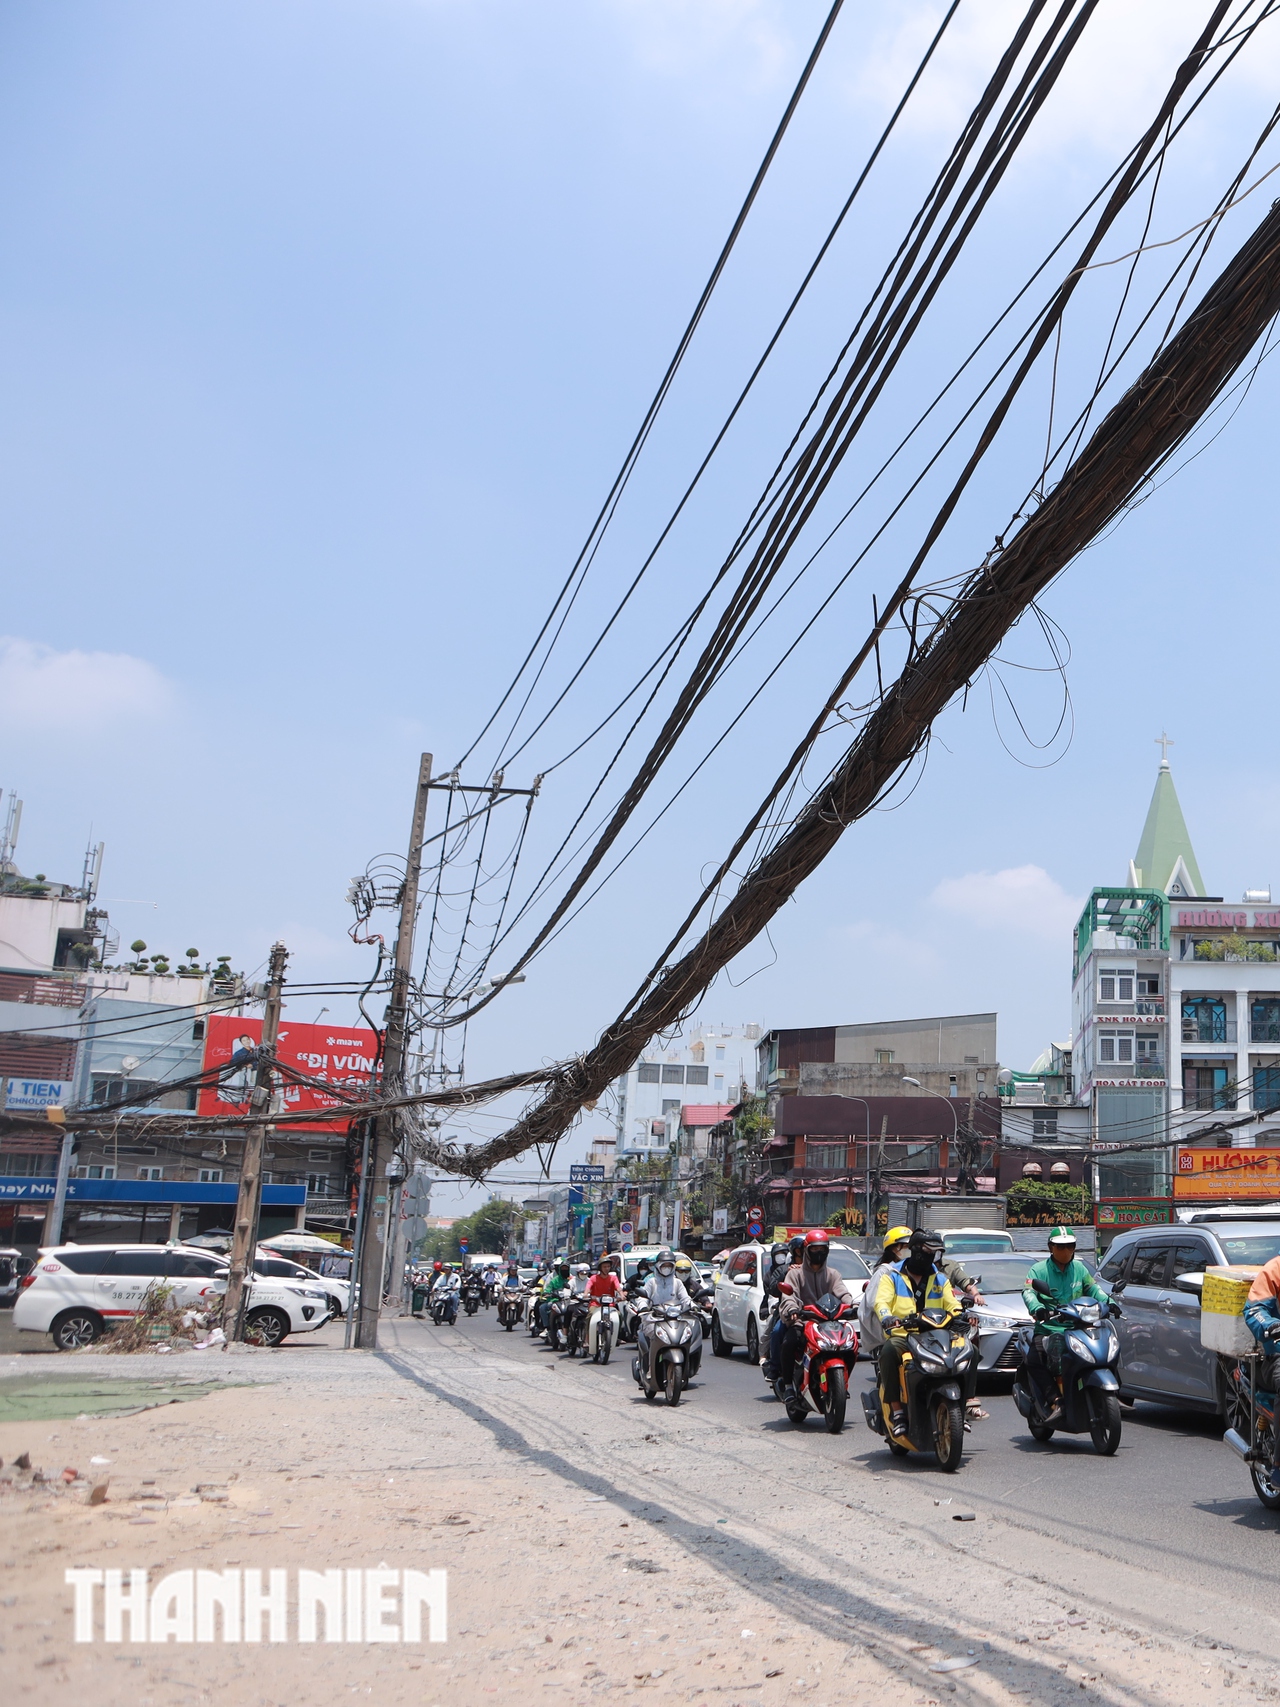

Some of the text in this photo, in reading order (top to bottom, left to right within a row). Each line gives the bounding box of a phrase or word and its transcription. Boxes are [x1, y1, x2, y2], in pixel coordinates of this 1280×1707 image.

[1178, 909, 1247, 927] HƯƠNG
[22, 1082, 62, 1097] TIEN
[1202, 1153, 1268, 1170] HƯƠNG
[572, 1172, 588, 1181] VẮC
[31, 1184, 76, 1194] Nht
[845, 1209, 888, 1225] Wis
[1118, 1210, 1166, 1222] HOA CÁT
